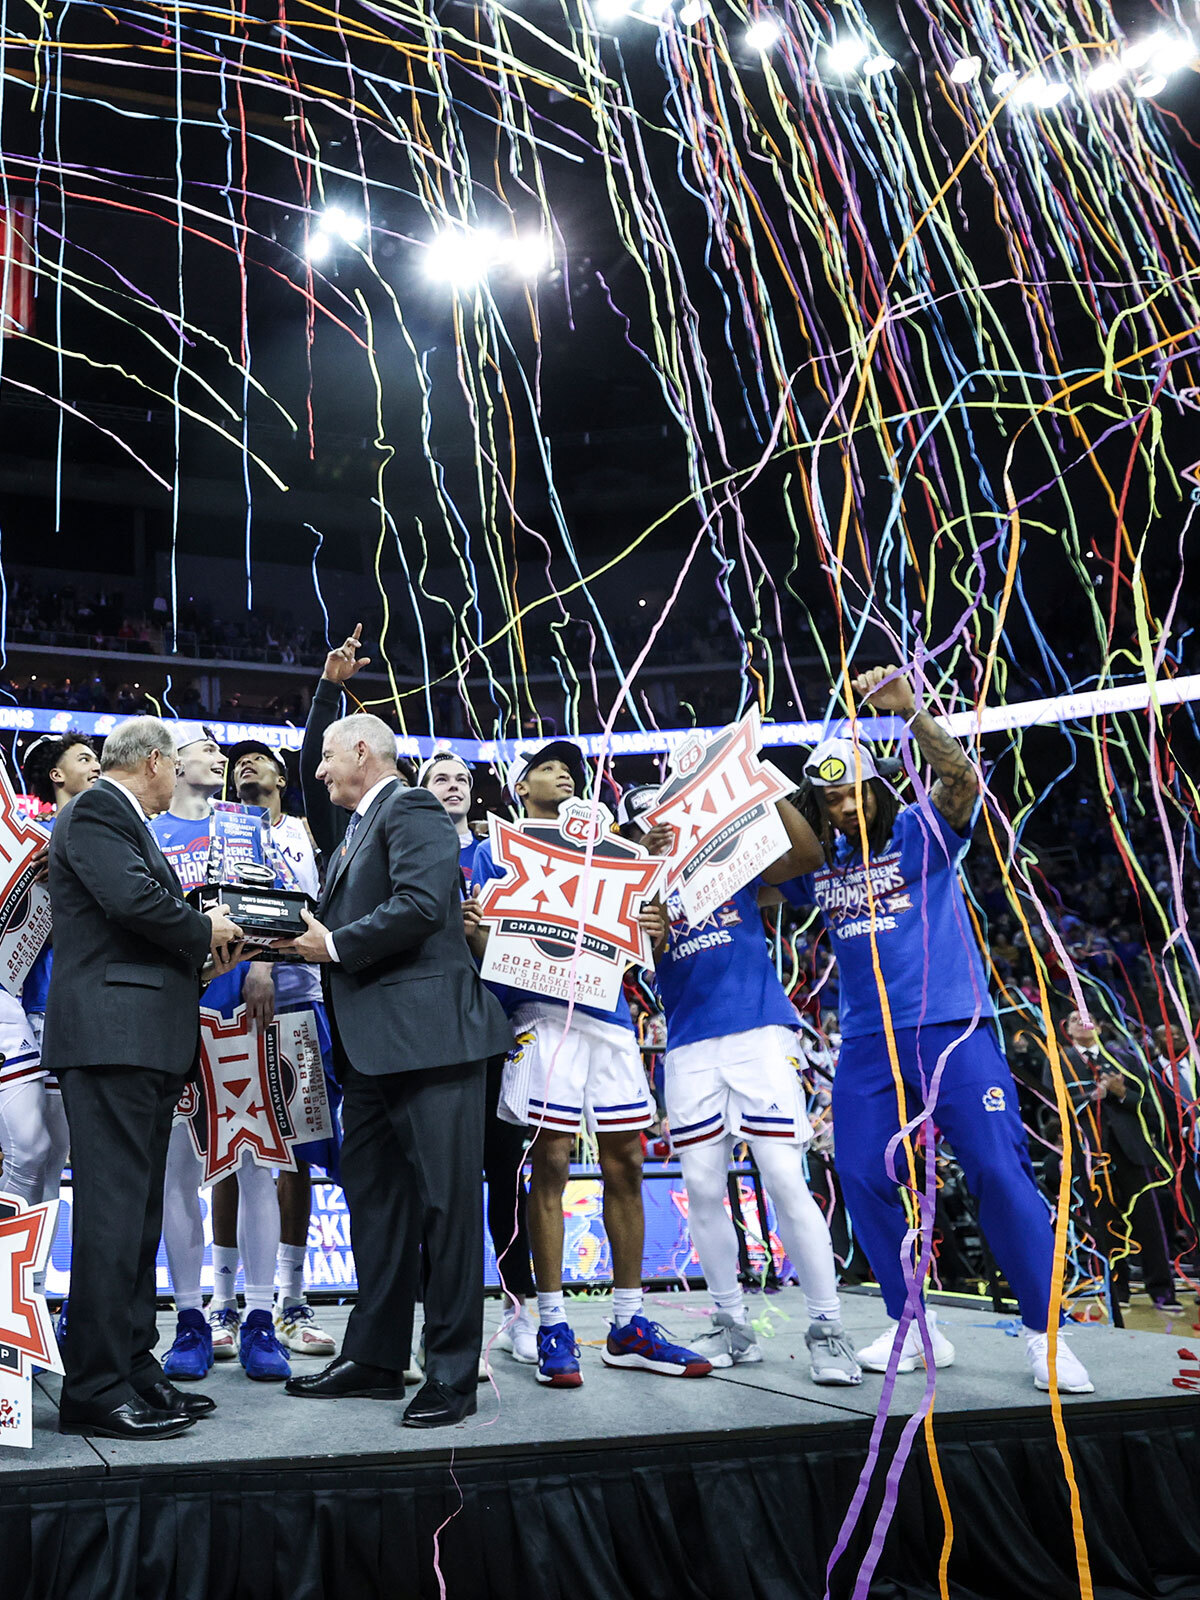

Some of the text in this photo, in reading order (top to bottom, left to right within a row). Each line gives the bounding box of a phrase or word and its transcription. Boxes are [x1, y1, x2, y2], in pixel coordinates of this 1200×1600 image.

[680, 746, 700, 771] 66
[571, 808, 601, 822] PHILLIS
[657, 731, 777, 870] XII
[568, 819, 592, 837] 66
[687, 808, 758, 873] CHAMPIONSHIP
[180, 853, 192, 864] 12
[696, 835, 769, 900] 2022 BIG 12
[492, 842, 650, 942] XII
[6, 934, 31, 970] 2022
[27, 904, 44, 931] BIG
[9, 950, 31, 983] MEN'S
[492, 962, 607, 998] MEN'S BASKEBALL
[501, 953, 542, 971] 2022
[584, 974, 602, 986] 12
[514, 976, 584, 1002] CHAMPIOS
[266, 1032, 287, 1130] CHAMPIONSHIP
[293, 1029, 315, 1125] 2022 BIG 12
[313, 1184, 346, 1211] 12
